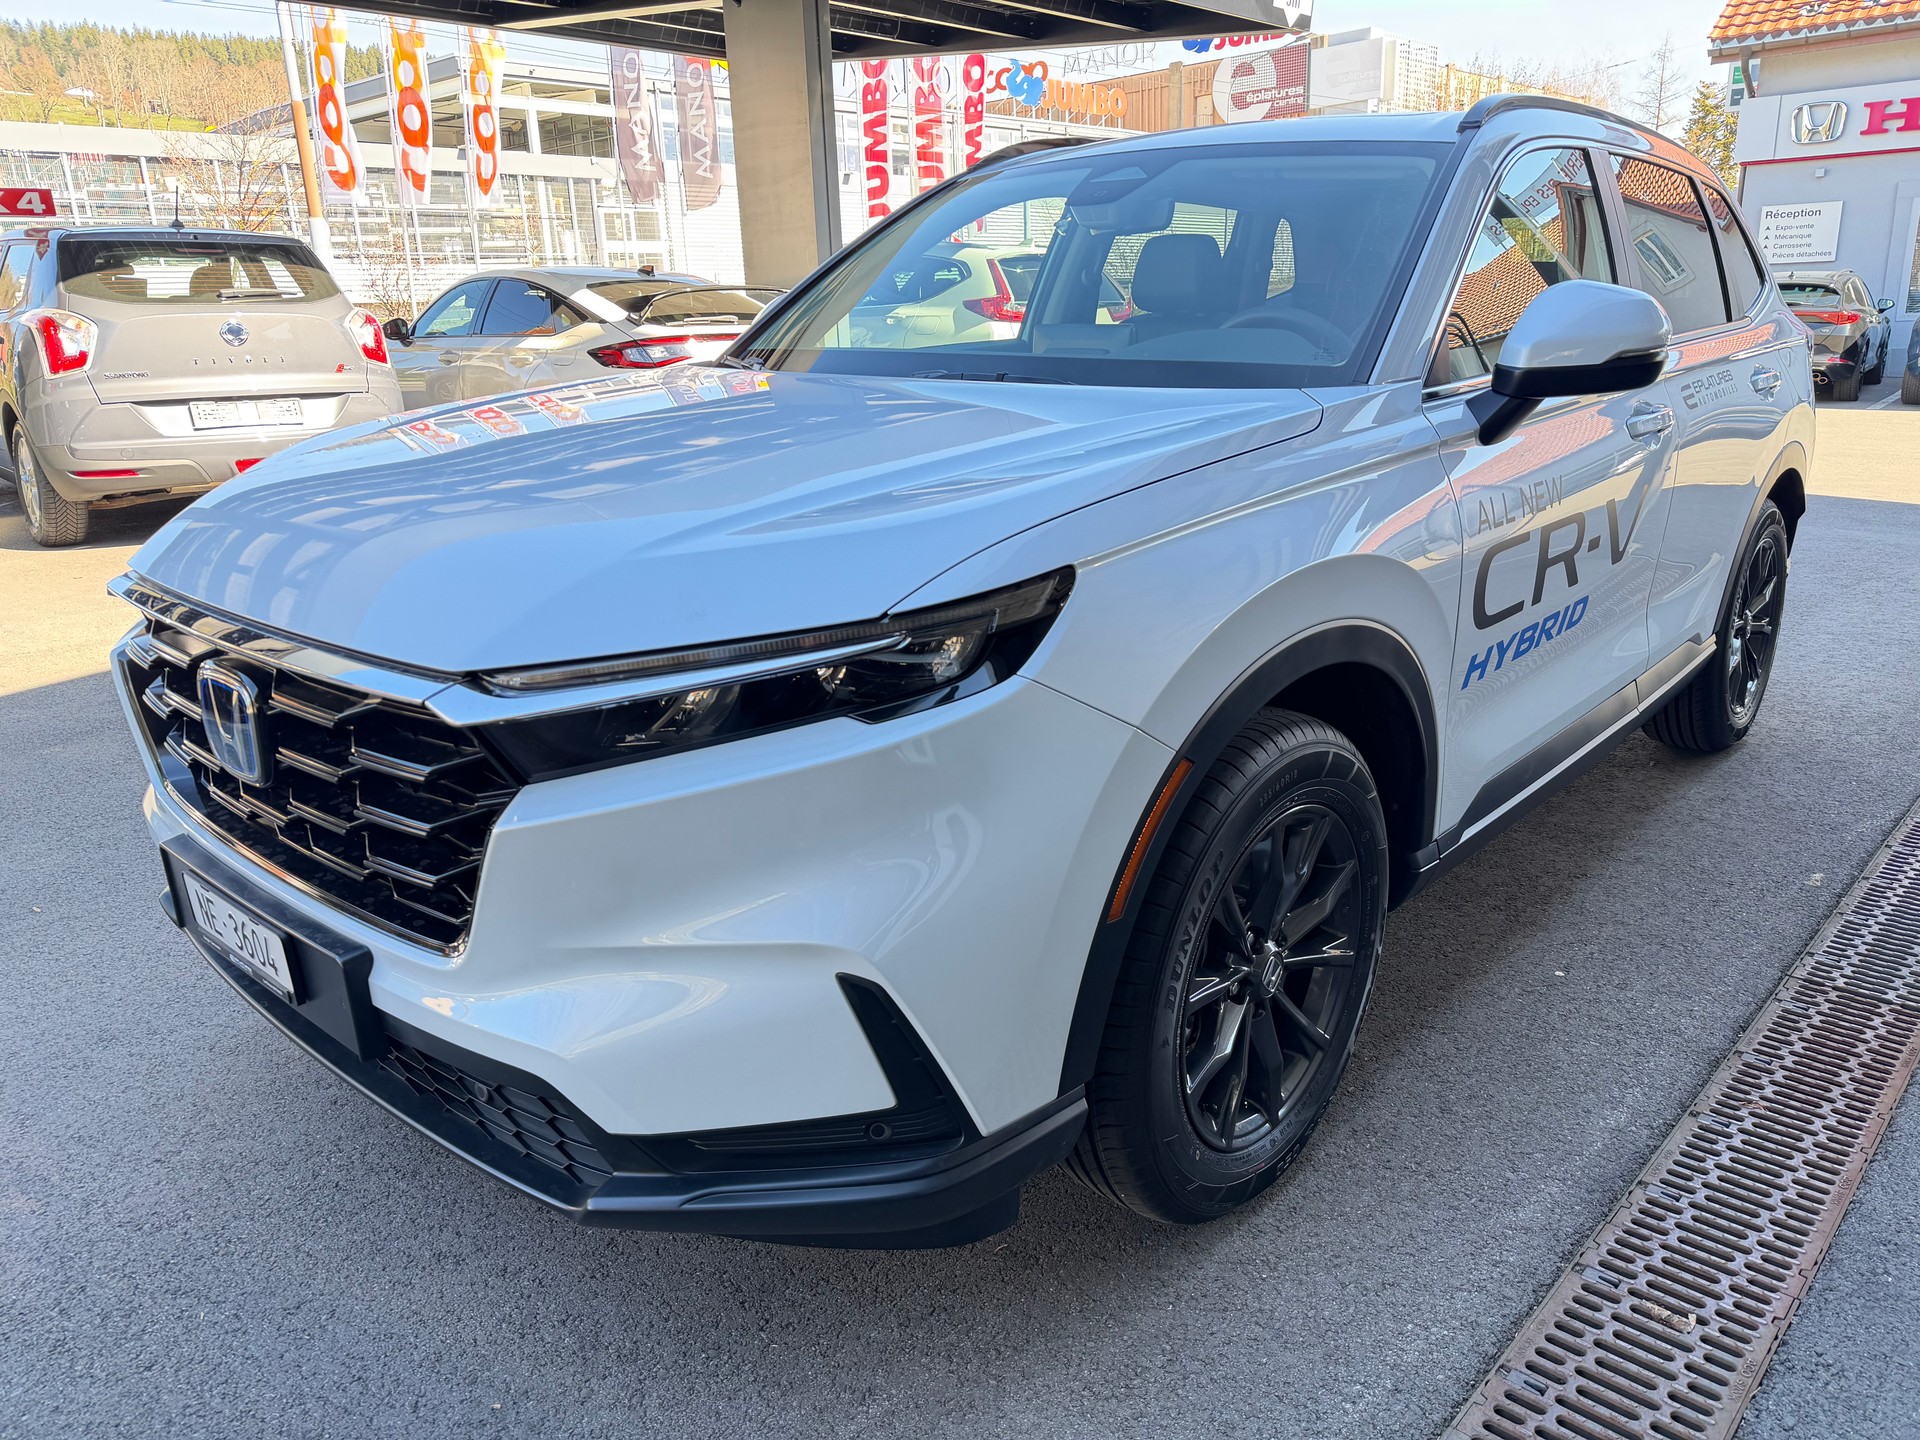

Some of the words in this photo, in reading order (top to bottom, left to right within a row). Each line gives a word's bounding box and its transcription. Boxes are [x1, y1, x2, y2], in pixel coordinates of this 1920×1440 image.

[1061, 41, 1157, 77] MANOR
[1040, 78, 1128, 118] JUMBO
[1246, 85, 1304, 103] éplatures
[1273, 96, 1304, 107] centre
[1765, 208, 1822, 219] Réception
[1775, 223, 1815, 231] Expo-vente
[1773, 242, 1812, 250] Carrosserie
[1796, 250, 1832, 258] détachées
[104, 371, 150, 379] SSANGYONG
[1692, 369, 1734, 394] EPLATURES
[1698, 383, 1739, 407] AUTOMOBILES
[1478, 492, 1516, 535] ALL
[1519, 475, 1563, 518] NEW
[1472, 484, 1649, 630] CR-V
[1461, 594, 1590, 691] HYBRID
[1165, 848, 1224, 1014] DUNLOP
